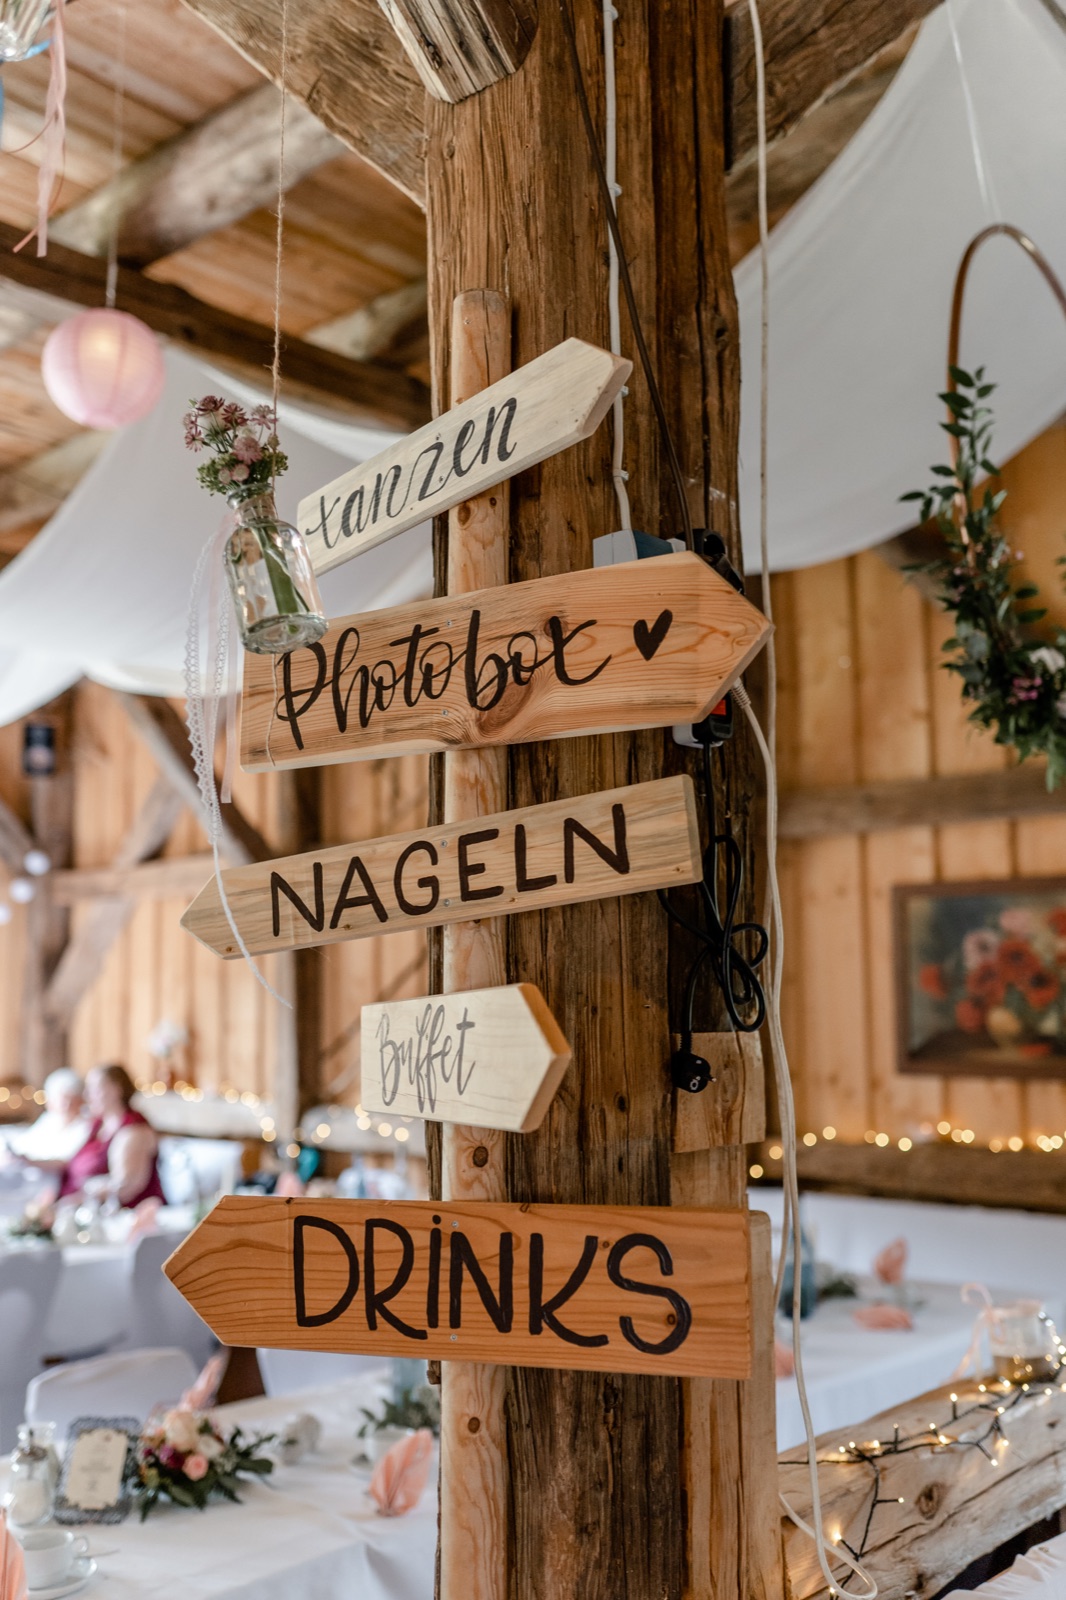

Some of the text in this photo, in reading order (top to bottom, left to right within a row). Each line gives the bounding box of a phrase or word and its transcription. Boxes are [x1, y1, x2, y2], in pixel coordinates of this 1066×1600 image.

[276, 609, 613, 750] Photobox
[270, 803, 630, 937] NAGELN
[375, 1003, 476, 1113] Buffet
